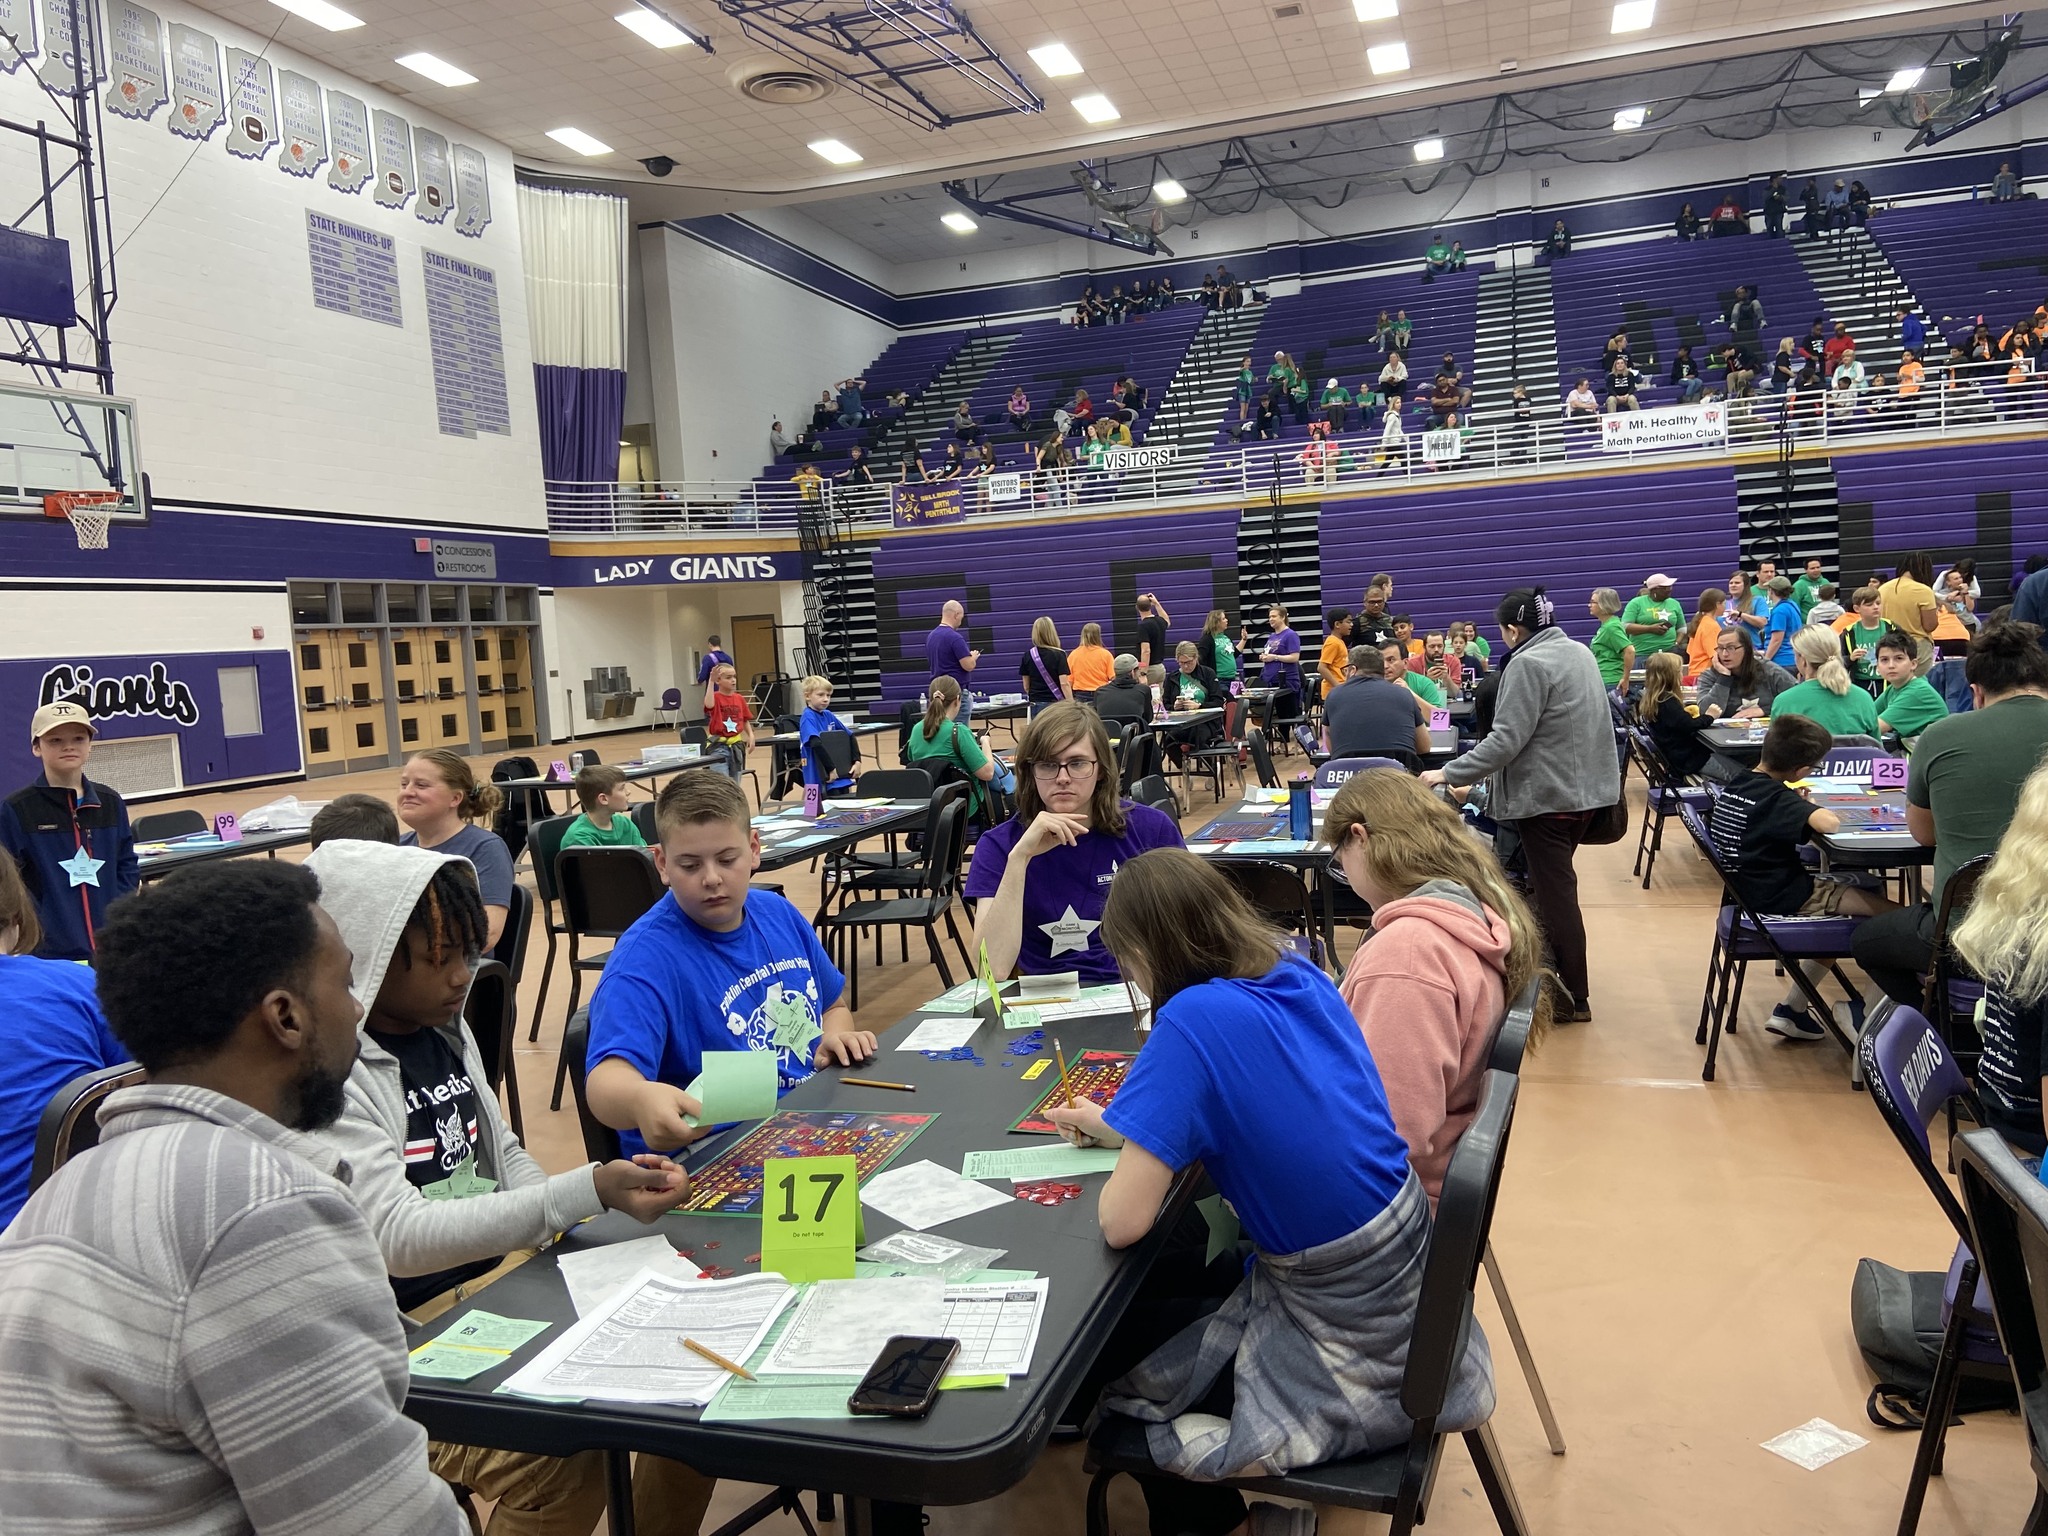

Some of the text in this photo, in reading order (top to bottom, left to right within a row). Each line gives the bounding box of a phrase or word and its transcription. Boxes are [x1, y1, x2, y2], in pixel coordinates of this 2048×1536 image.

[124, 8, 142, 22] 1995
[127, 44, 146, 59] BOYS
[115, 51, 160, 76] BASKETBALL
[187, 68, 205, 82] BOYS
[239, 67, 258, 82] STATE
[176, 75, 218, 98] BASKETBALL
[234, 76, 267, 96] CHAMPION
[243, 91, 259, 104] BOYS
[237, 97, 267, 118] FOOTBALL
[285, 117, 321, 138] BASKETBALL
[334, 116, 362, 133] CHAMPION
[379, 135, 405, 150] CHAMPION
[1873, 131, 1881, 142] 17
[333, 136, 367, 156] BASKETBALL
[459, 167, 482, 183] CHAMPION
[1541, 177, 1550, 188] 16
[310, 213, 392, 251] STATE RUNNERS-UP
[1190, 230, 1198, 240] 15
[426, 251, 493, 283] STATE FINAL FOUR
[959, 262, 966, 272] 14
[1629, 415, 1698, 430] Mt. Healthy
[1607, 428, 1721, 447] Math Pentathlon Club
[1431, 442, 1452, 450] MEDIA
[1105, 449, 1169, 468] VISITORS
[990, 478, 1018, 487] VISITORS
[920, 489, 961, 502] BELLBROOK
[992, 486, 1017, 496] PLAYERS
[925, 506, 961, 519] PENTATHLON
[933, 500, 950, 510] MATH
[444, 546, 492, 557] CONCESSIONS
[445, 563, 487, 573] RESTROOMS
[594, 556, 776, 583] LADY GIANTS
[38, 661, 199, 727] Giants
[1432, 711, 1448, 721] 27
[554, 762, 566, 772] 99
[1833, 759, 1873, 776] DAVI
[1878, 763, 1905, 779] 25
[1326, 770, 1354, 784] BEN
[806, 788, 817, 801] 29
[218, 814, 235, 829] 99
[768, 958, 797, 974] Junior
[794, 957, 811, 972] Hig
[1911, 1028, 1943, 1093] DAVIS
[778, 1173, 845, 1222] 17
